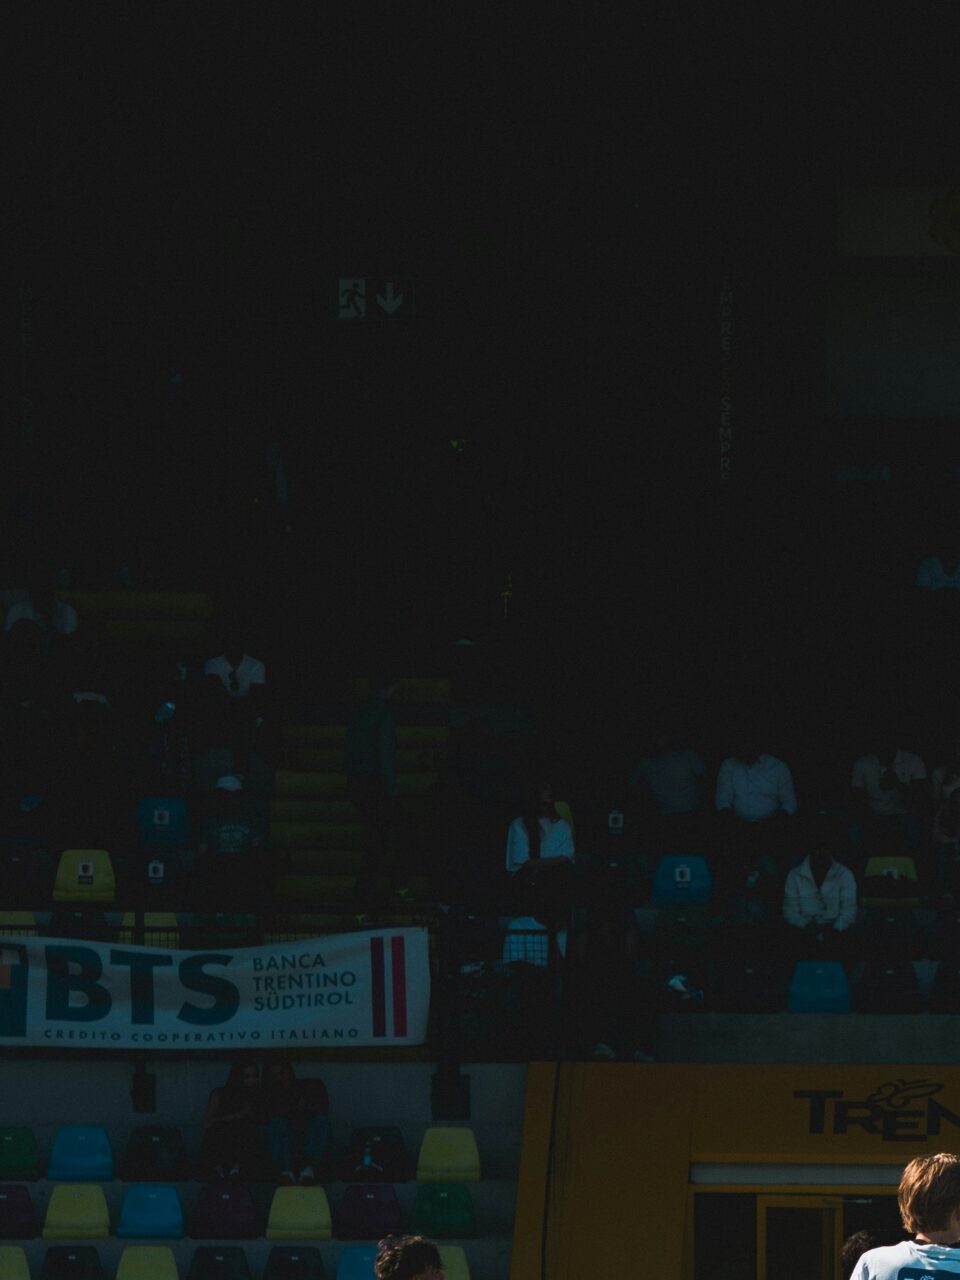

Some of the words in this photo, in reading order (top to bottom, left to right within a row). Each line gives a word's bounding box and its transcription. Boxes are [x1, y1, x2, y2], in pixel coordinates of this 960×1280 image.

[253, 953, 326, 972] BANCA
[44, 944, 242, 1026] BTS
[253, 971, 357, 992] TRENTINO
[254, 990, 354, 1012] SÜDTIROL
[44, 1028, 122, 1041] CREDITO
[131, 1028, 262, 1043] COOPERATIVO
[271, 1027, 360, 1040] ITALIANO
